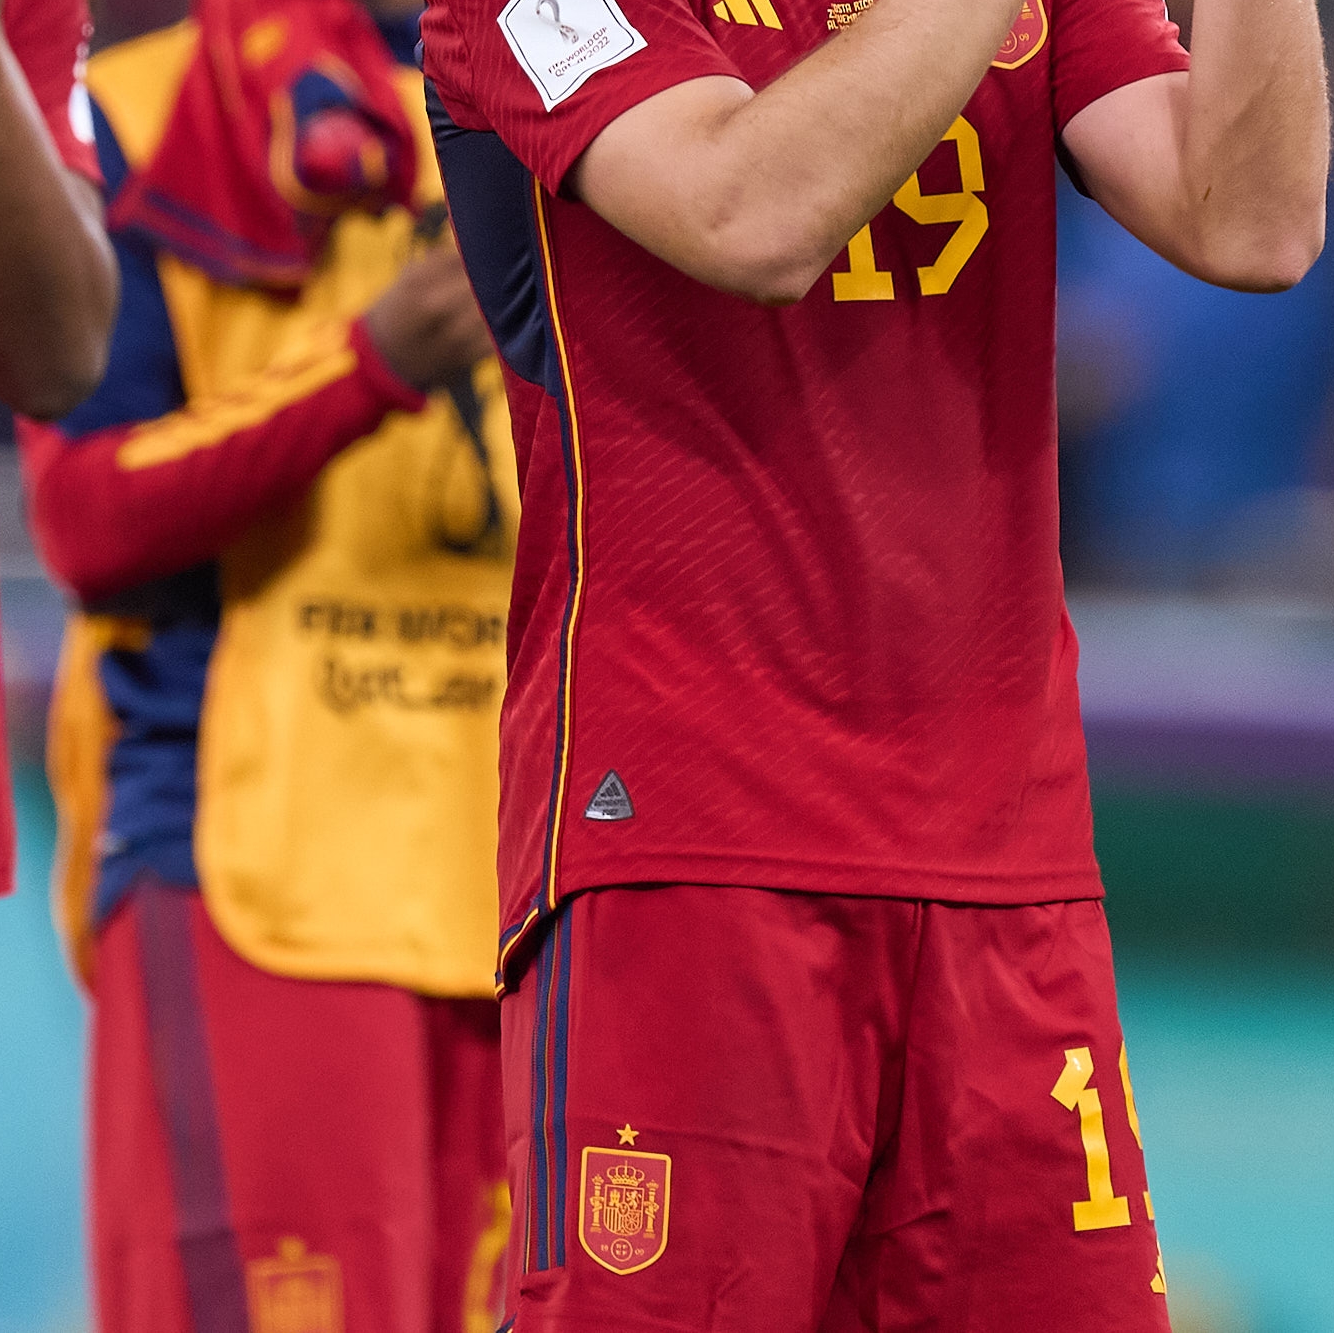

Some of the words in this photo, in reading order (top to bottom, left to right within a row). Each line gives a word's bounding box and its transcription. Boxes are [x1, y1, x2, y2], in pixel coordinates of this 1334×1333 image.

[566, 38, 594, 62] WORLD
[586, 36, 610, 58] 2022
[1050, 1040, 1144, 1232] 1
